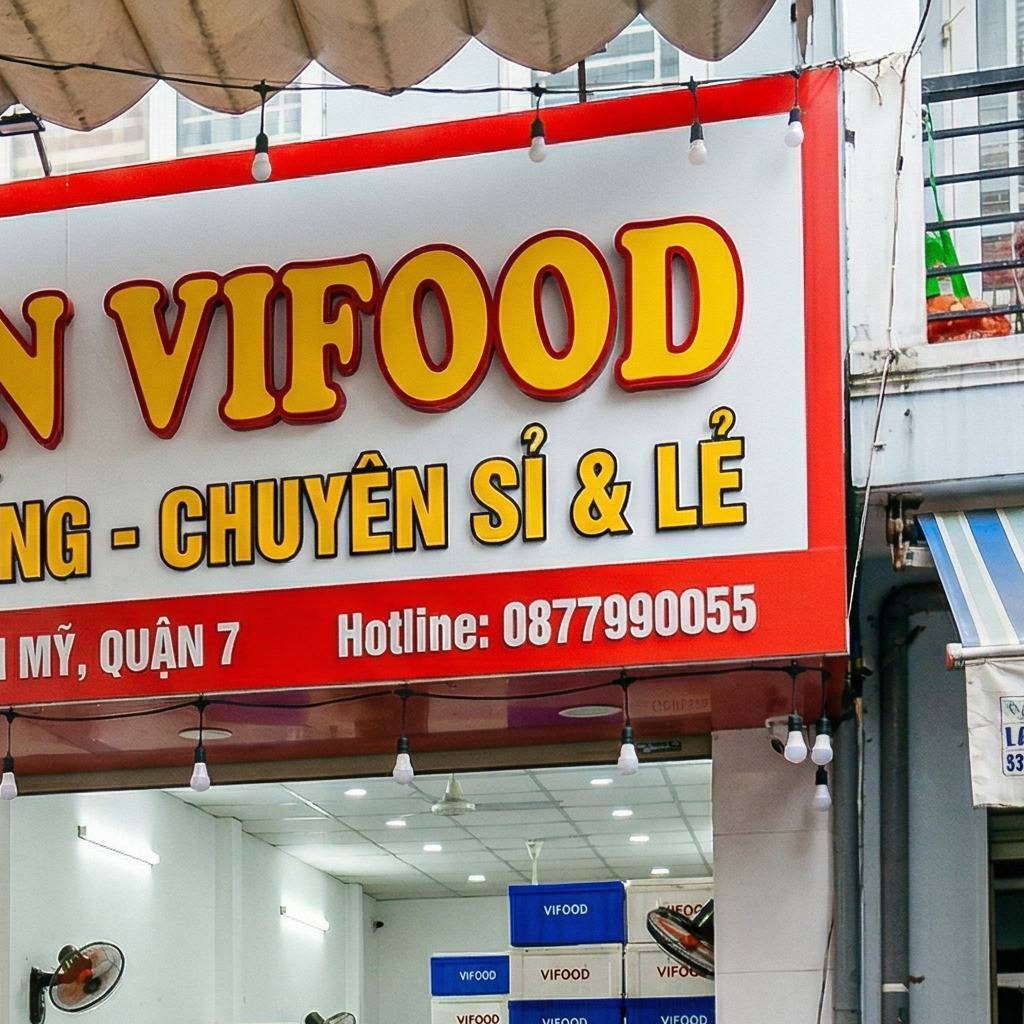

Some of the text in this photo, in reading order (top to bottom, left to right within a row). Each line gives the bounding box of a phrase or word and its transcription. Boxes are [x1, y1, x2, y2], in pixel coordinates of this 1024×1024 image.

[104, 215, 744, 440] VIFOOD
[159, 450, 449, 572] CHUYÊN
[470, 422, 548, 546] SỈ
[572, 448, 633, 538] &
[654, 405, 747, 532] LẺ
[337, 583, 758, 659] Hotline: 0877990055
[20, 623, 87, 682] MỸ,
[99, 615, 205, 680] QUẬN
[217, 621, 241, 667] 7
[543, 903, 588, 916] VIFOOD
[459, 970, 497, 981] VIFOOD
[540, 968, 590, 981] VIFOOD
[456, 1014, 500, 1024] VIFOOD
